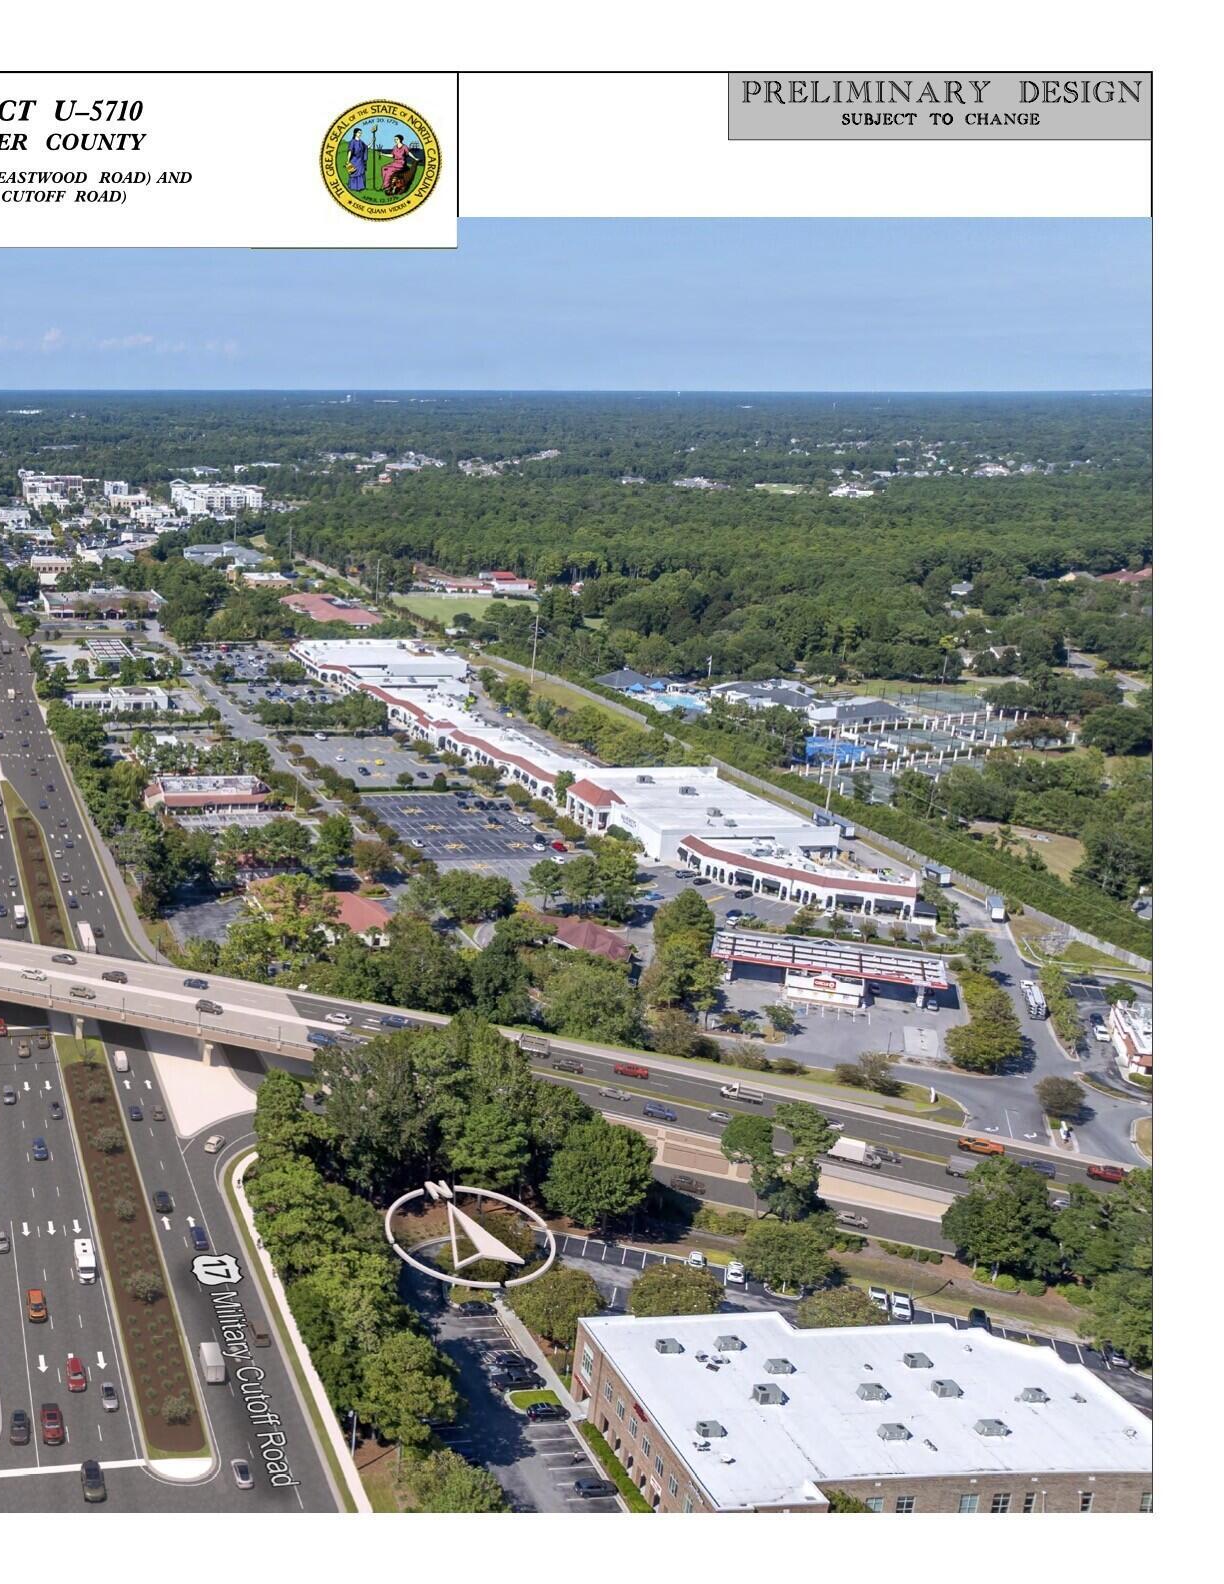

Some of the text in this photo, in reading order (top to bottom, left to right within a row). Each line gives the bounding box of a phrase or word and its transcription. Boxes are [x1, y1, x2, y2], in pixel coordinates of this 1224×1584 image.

[742, 80, 1143, 105] PRELIMINARY DESIGN
[370, 104, 398, 116] STATE
[841, 112, 1041, 126] SUBJECT TO CHANGE
[330, 120, 350, 143] SEAL
[406, 114, 432, 145] NORTH
[45, 133, 148, 151] COUNTY
[325, 143, 336, 177] GREAT
[98, 171, 151, 186] ROAD)
[155, 171, 193, 184] AND
[414, 147, 436, 199] CAROLINA
[1, 190, 67, 203] CUTOFF
[74, 190, 127, 205] ROAD)
[329, 178, 345, 199] THE
